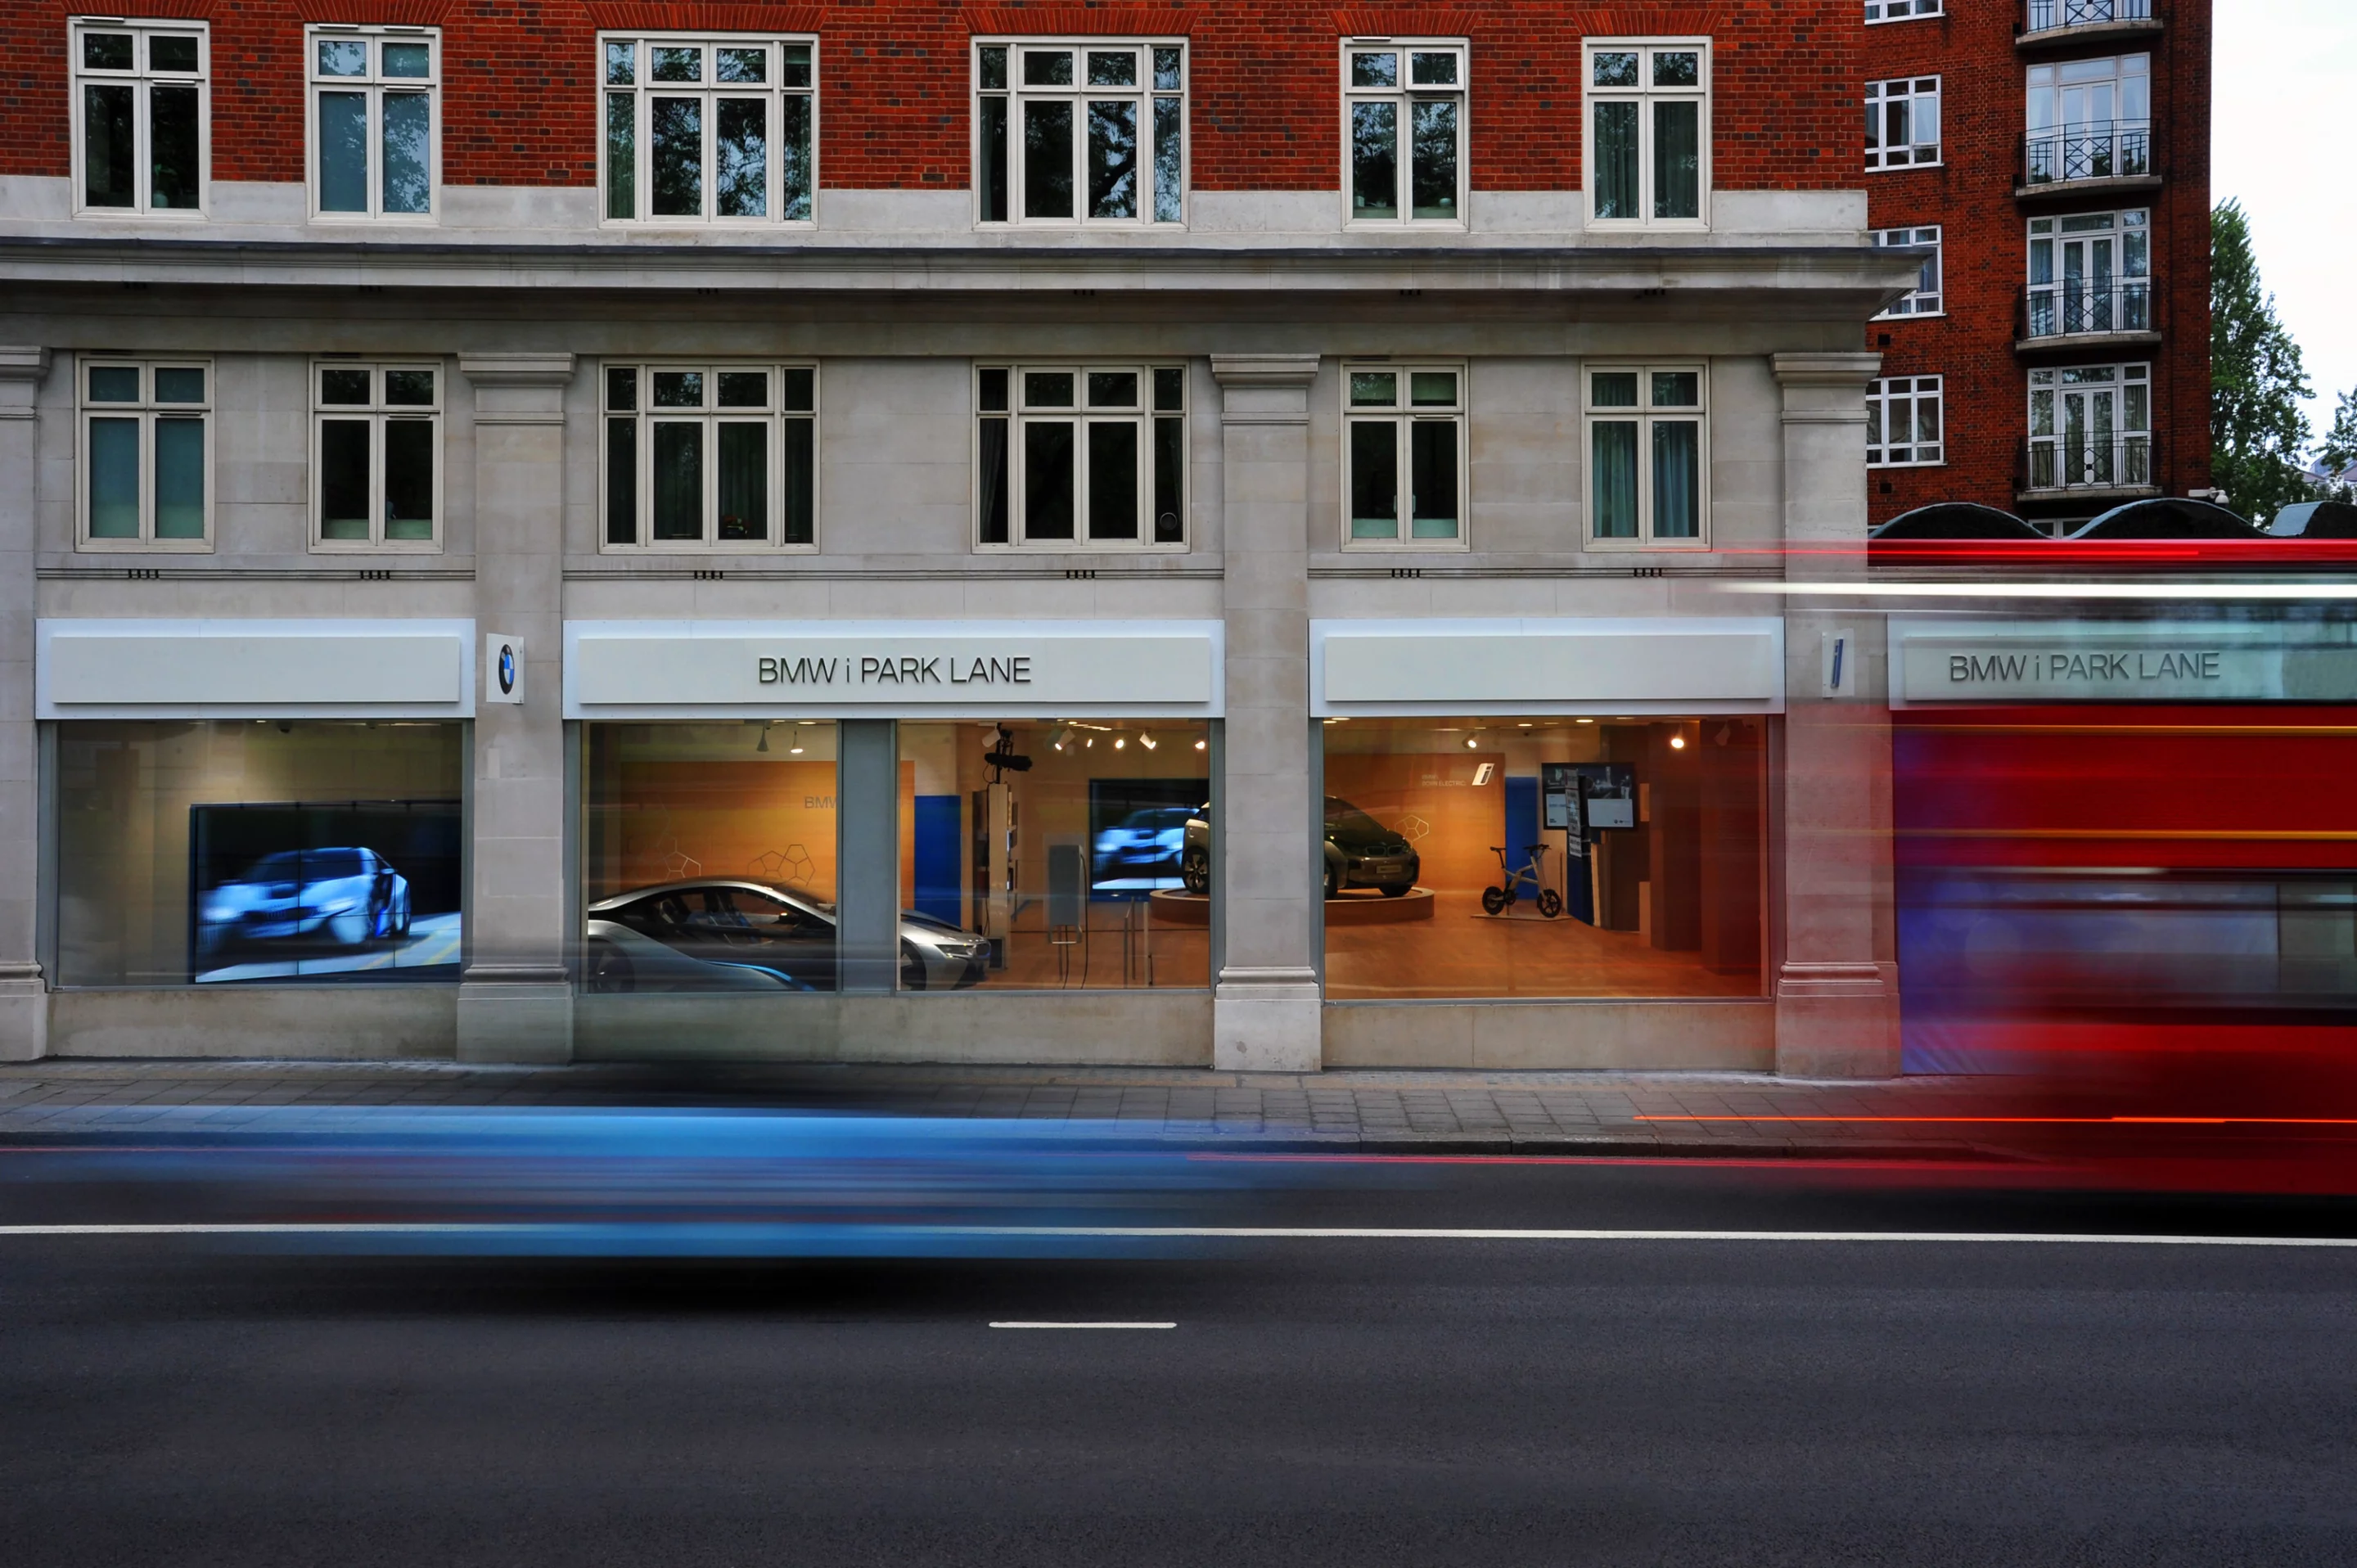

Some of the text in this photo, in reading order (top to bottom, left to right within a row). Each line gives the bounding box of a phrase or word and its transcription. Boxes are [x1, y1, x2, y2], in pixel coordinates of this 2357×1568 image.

[759, 657, 1031, 683] BMW i PARK LANE
[1950, 652, 2220, 682] BMW i PARK LANE
